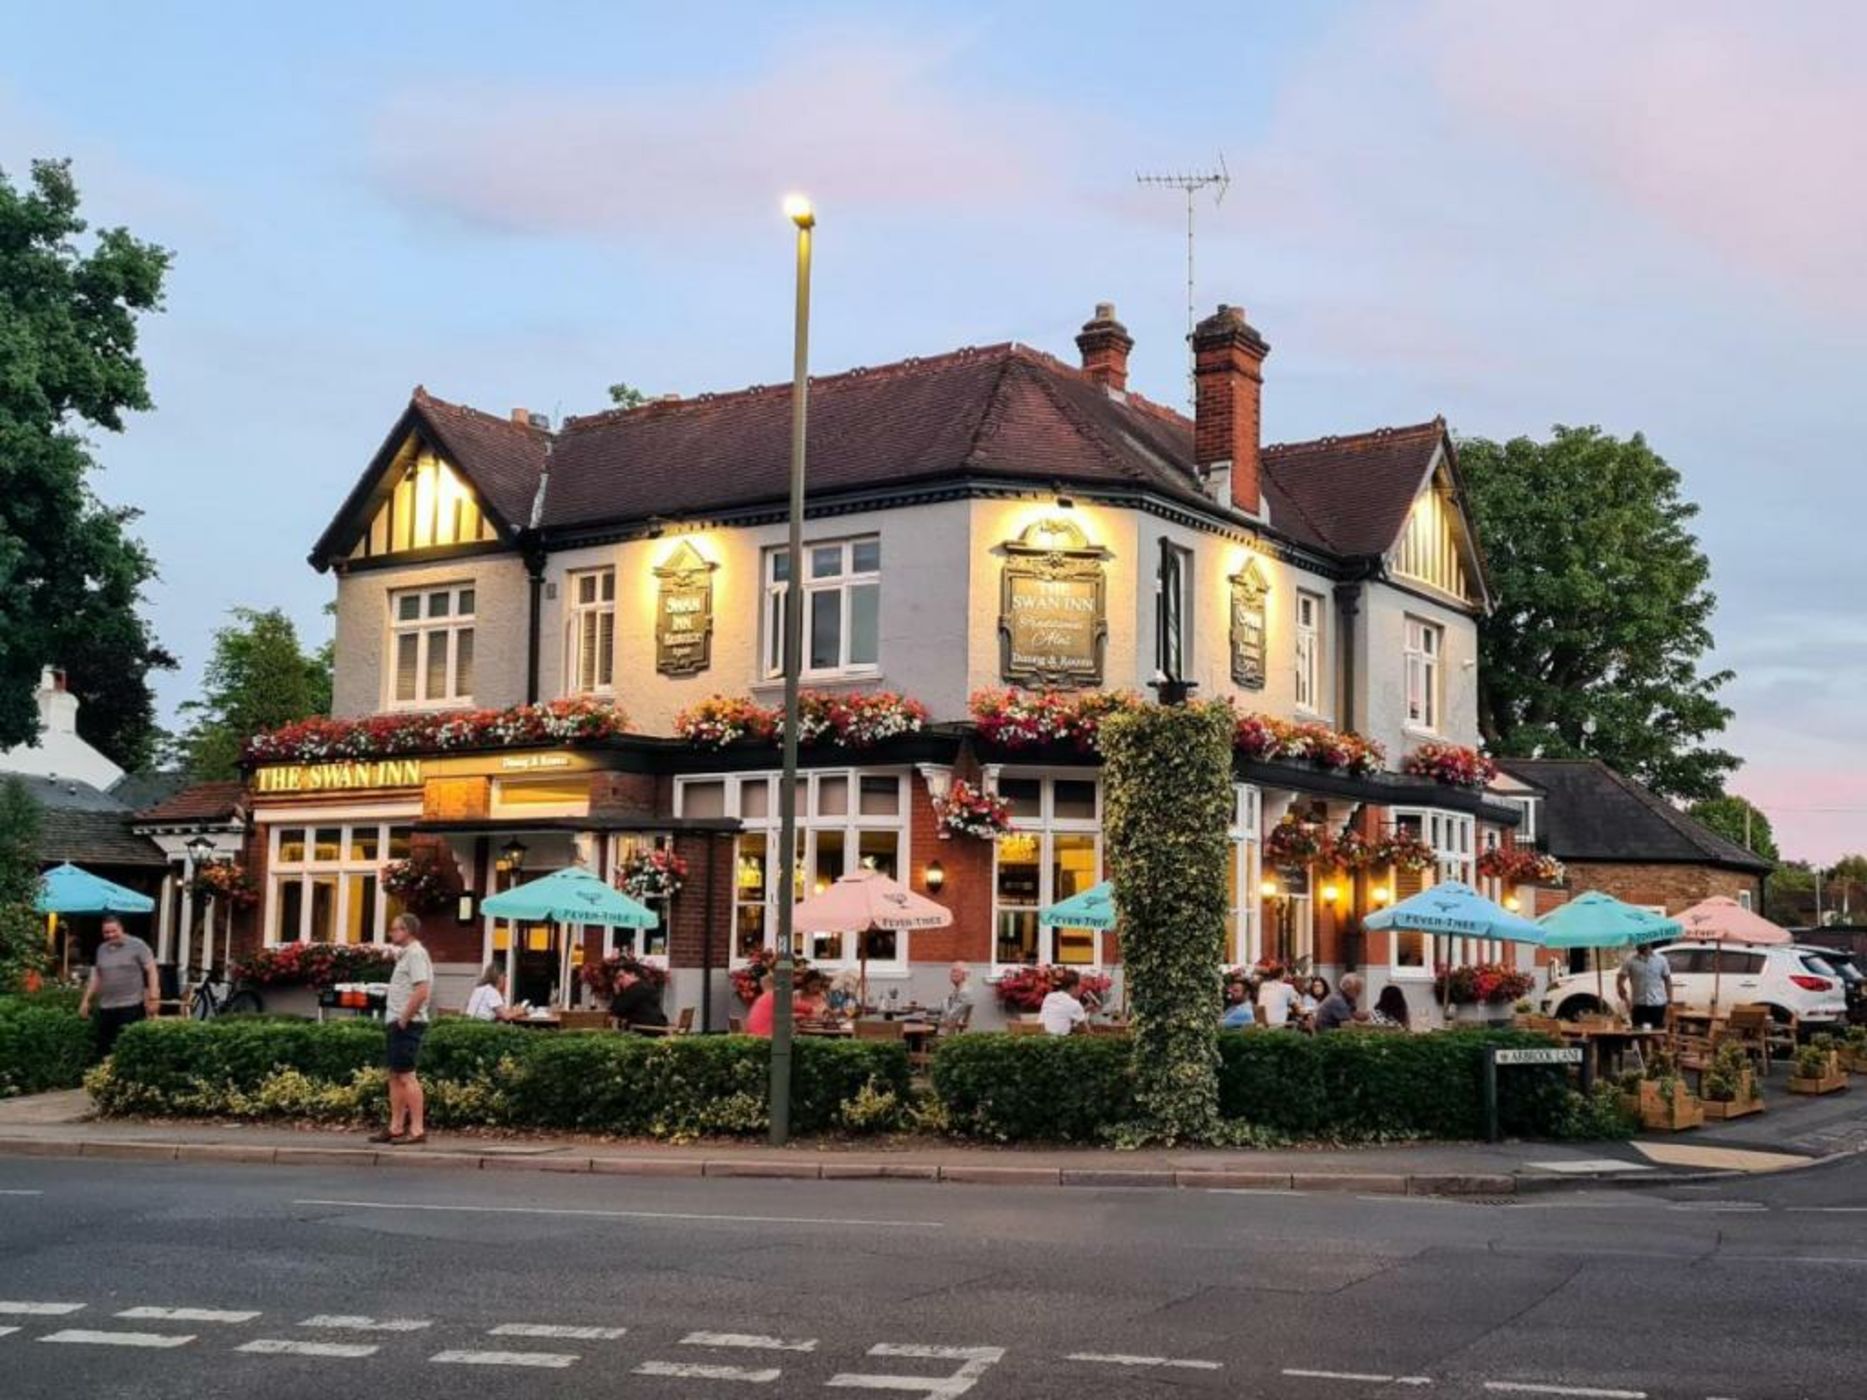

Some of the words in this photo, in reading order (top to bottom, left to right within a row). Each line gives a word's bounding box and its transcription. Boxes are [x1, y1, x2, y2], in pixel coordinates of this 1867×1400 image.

[1013, 596, 1057, 609] SWAN
[1065, 597, 1095, 611] INN
[256, 767, 301, 793] THE
[309, 762, 371, 788] SWAN
[378, 760, 420, 785] INN
